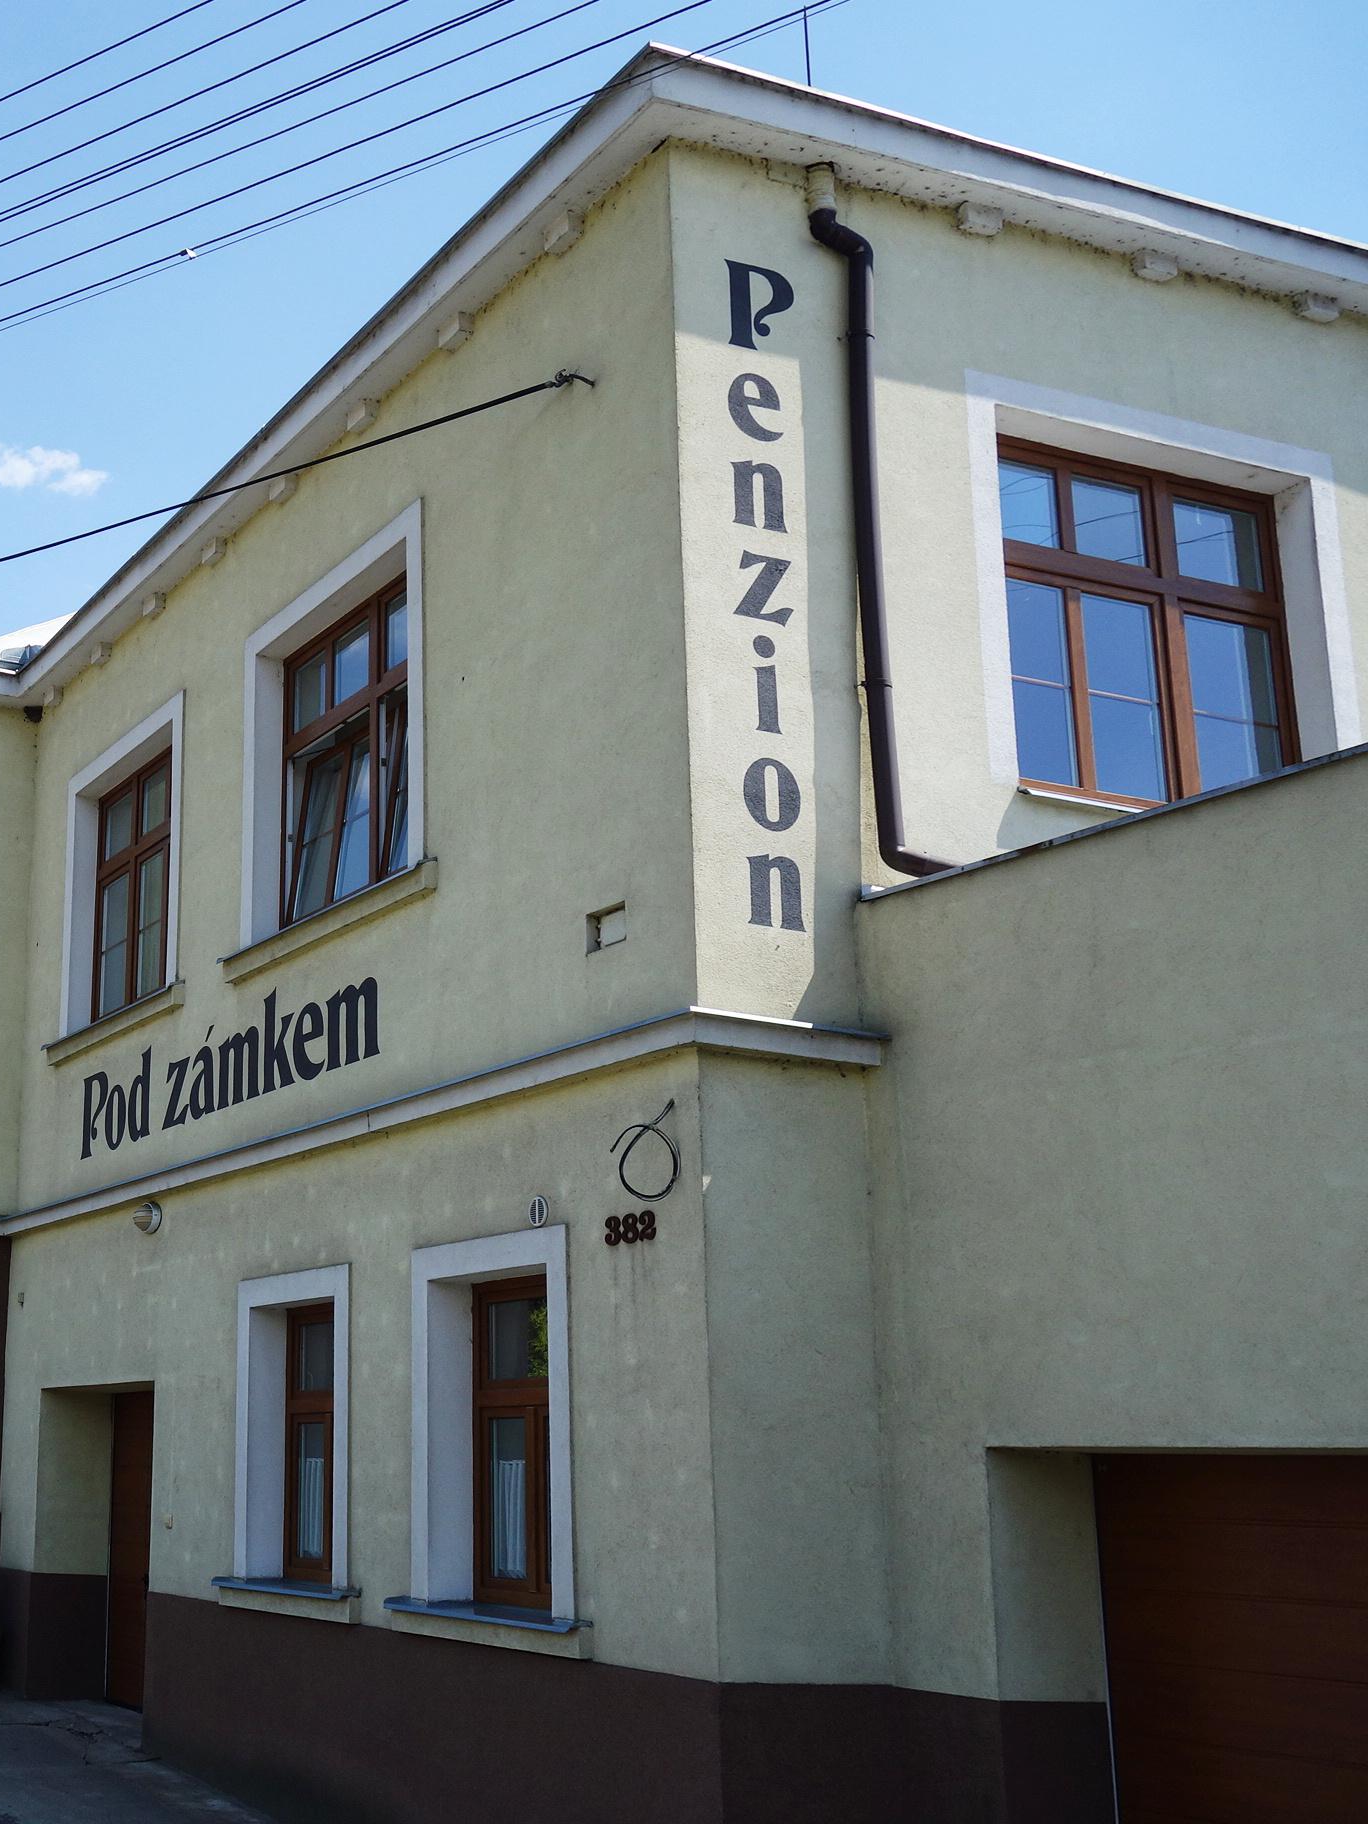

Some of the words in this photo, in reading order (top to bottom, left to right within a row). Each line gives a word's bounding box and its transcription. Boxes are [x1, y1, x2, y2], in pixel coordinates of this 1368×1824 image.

[724, 258, 807, 933] Penzion
[80, 1045, 152, 1160] Pod
[162, 976, 381, 1131] zámkem
[604, 1209, 657, 1247] 382
